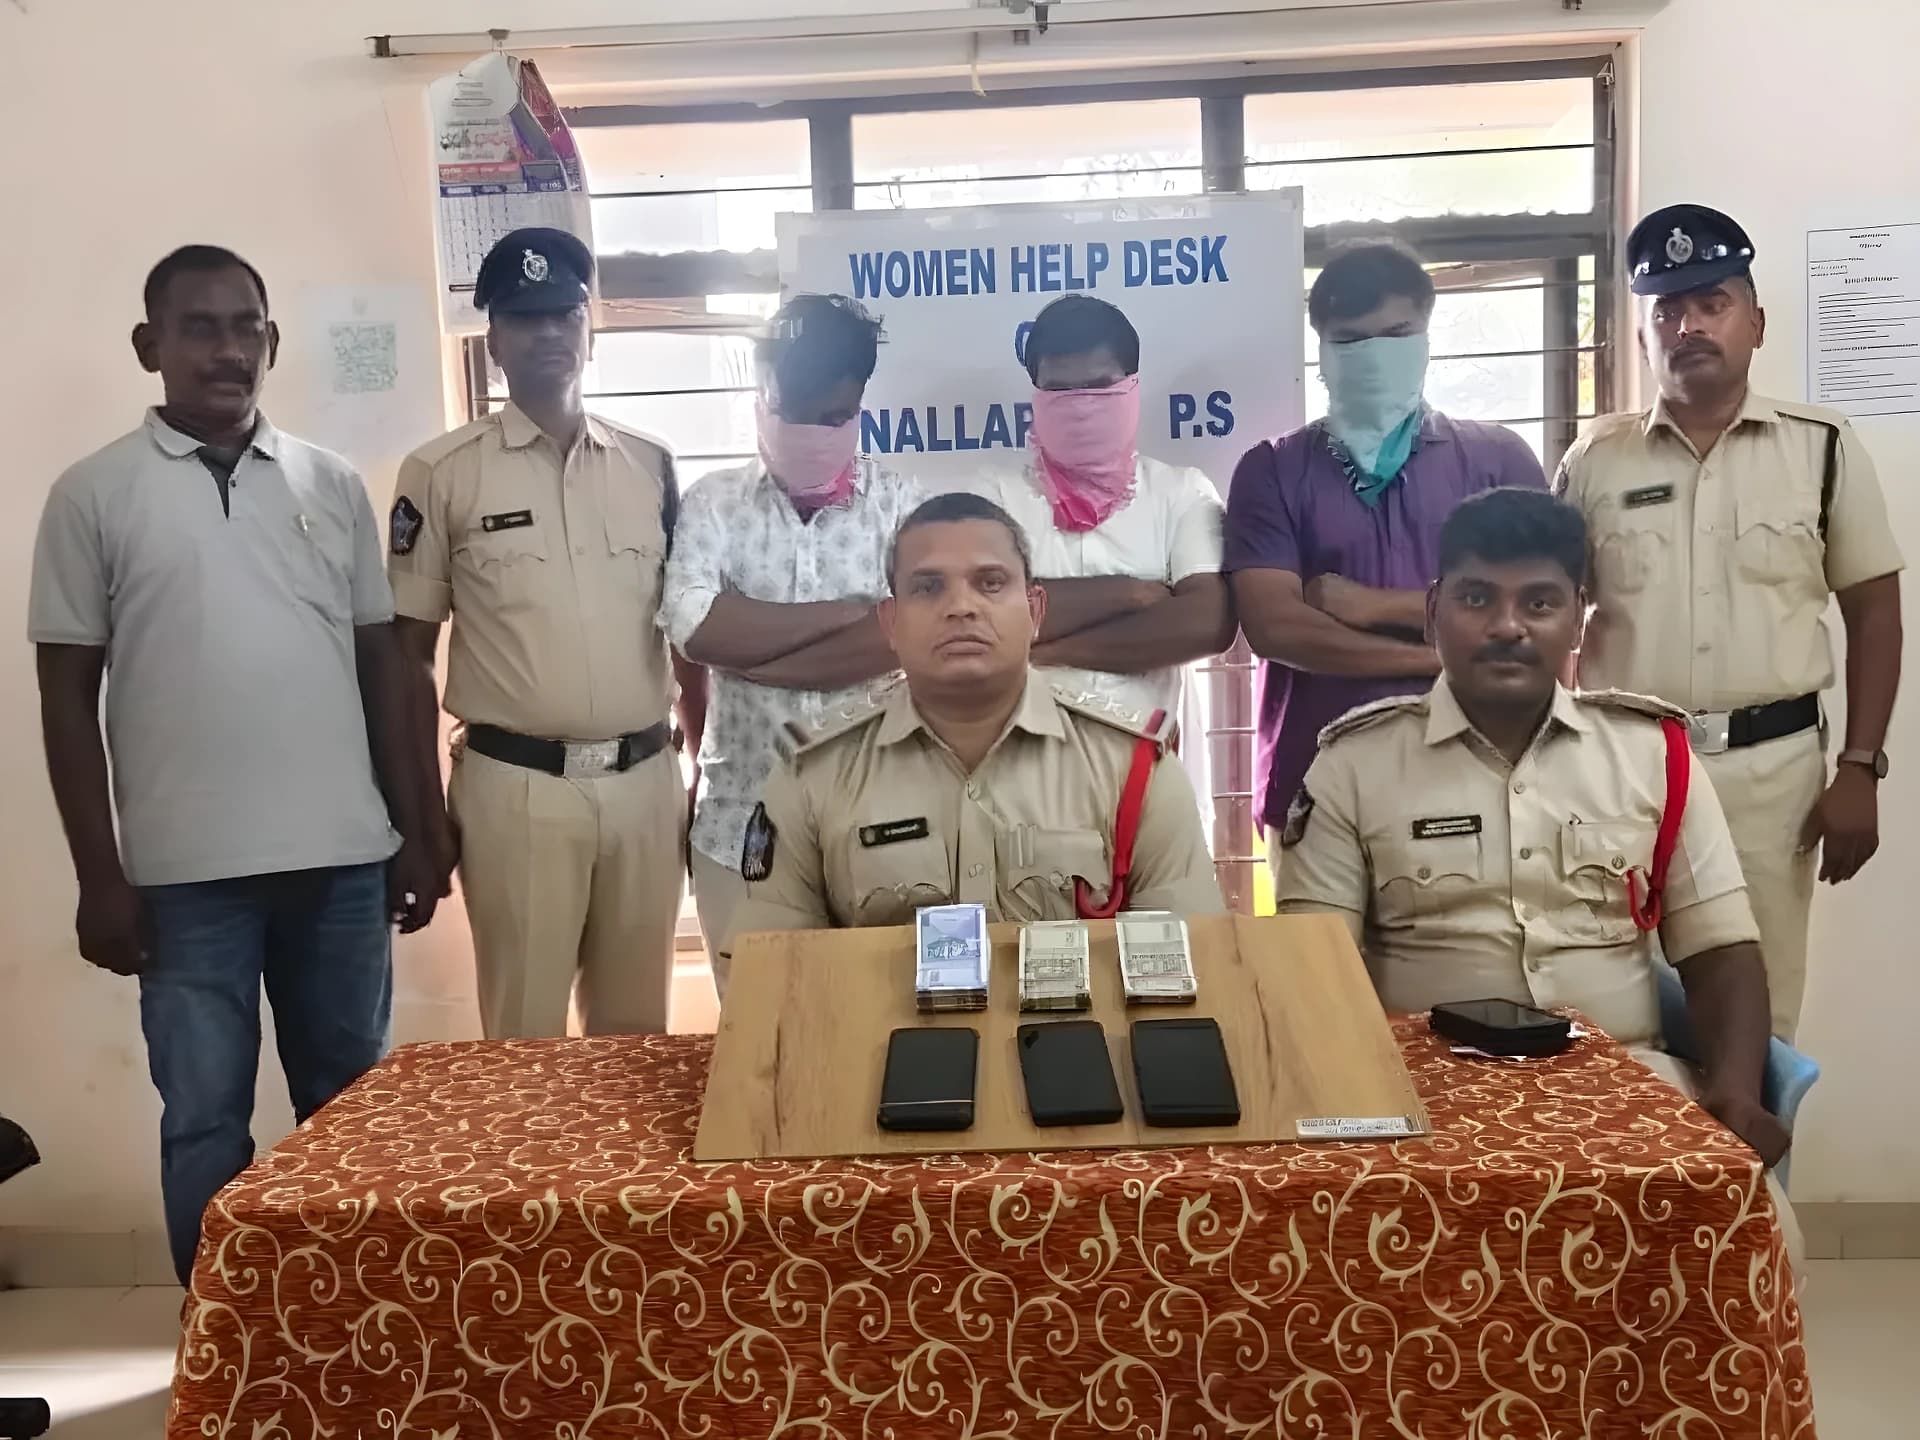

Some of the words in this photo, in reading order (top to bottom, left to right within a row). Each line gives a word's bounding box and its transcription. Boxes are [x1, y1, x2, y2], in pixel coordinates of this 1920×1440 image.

[849, 248, 996, 299] WOMEN
[1011, 242, 1109, 293] HELP
[1124, 235, 1229, 287] DESK
[861, 402, 1033, 454] NALLAP
[1169, 390, 1234, 438] P.S
